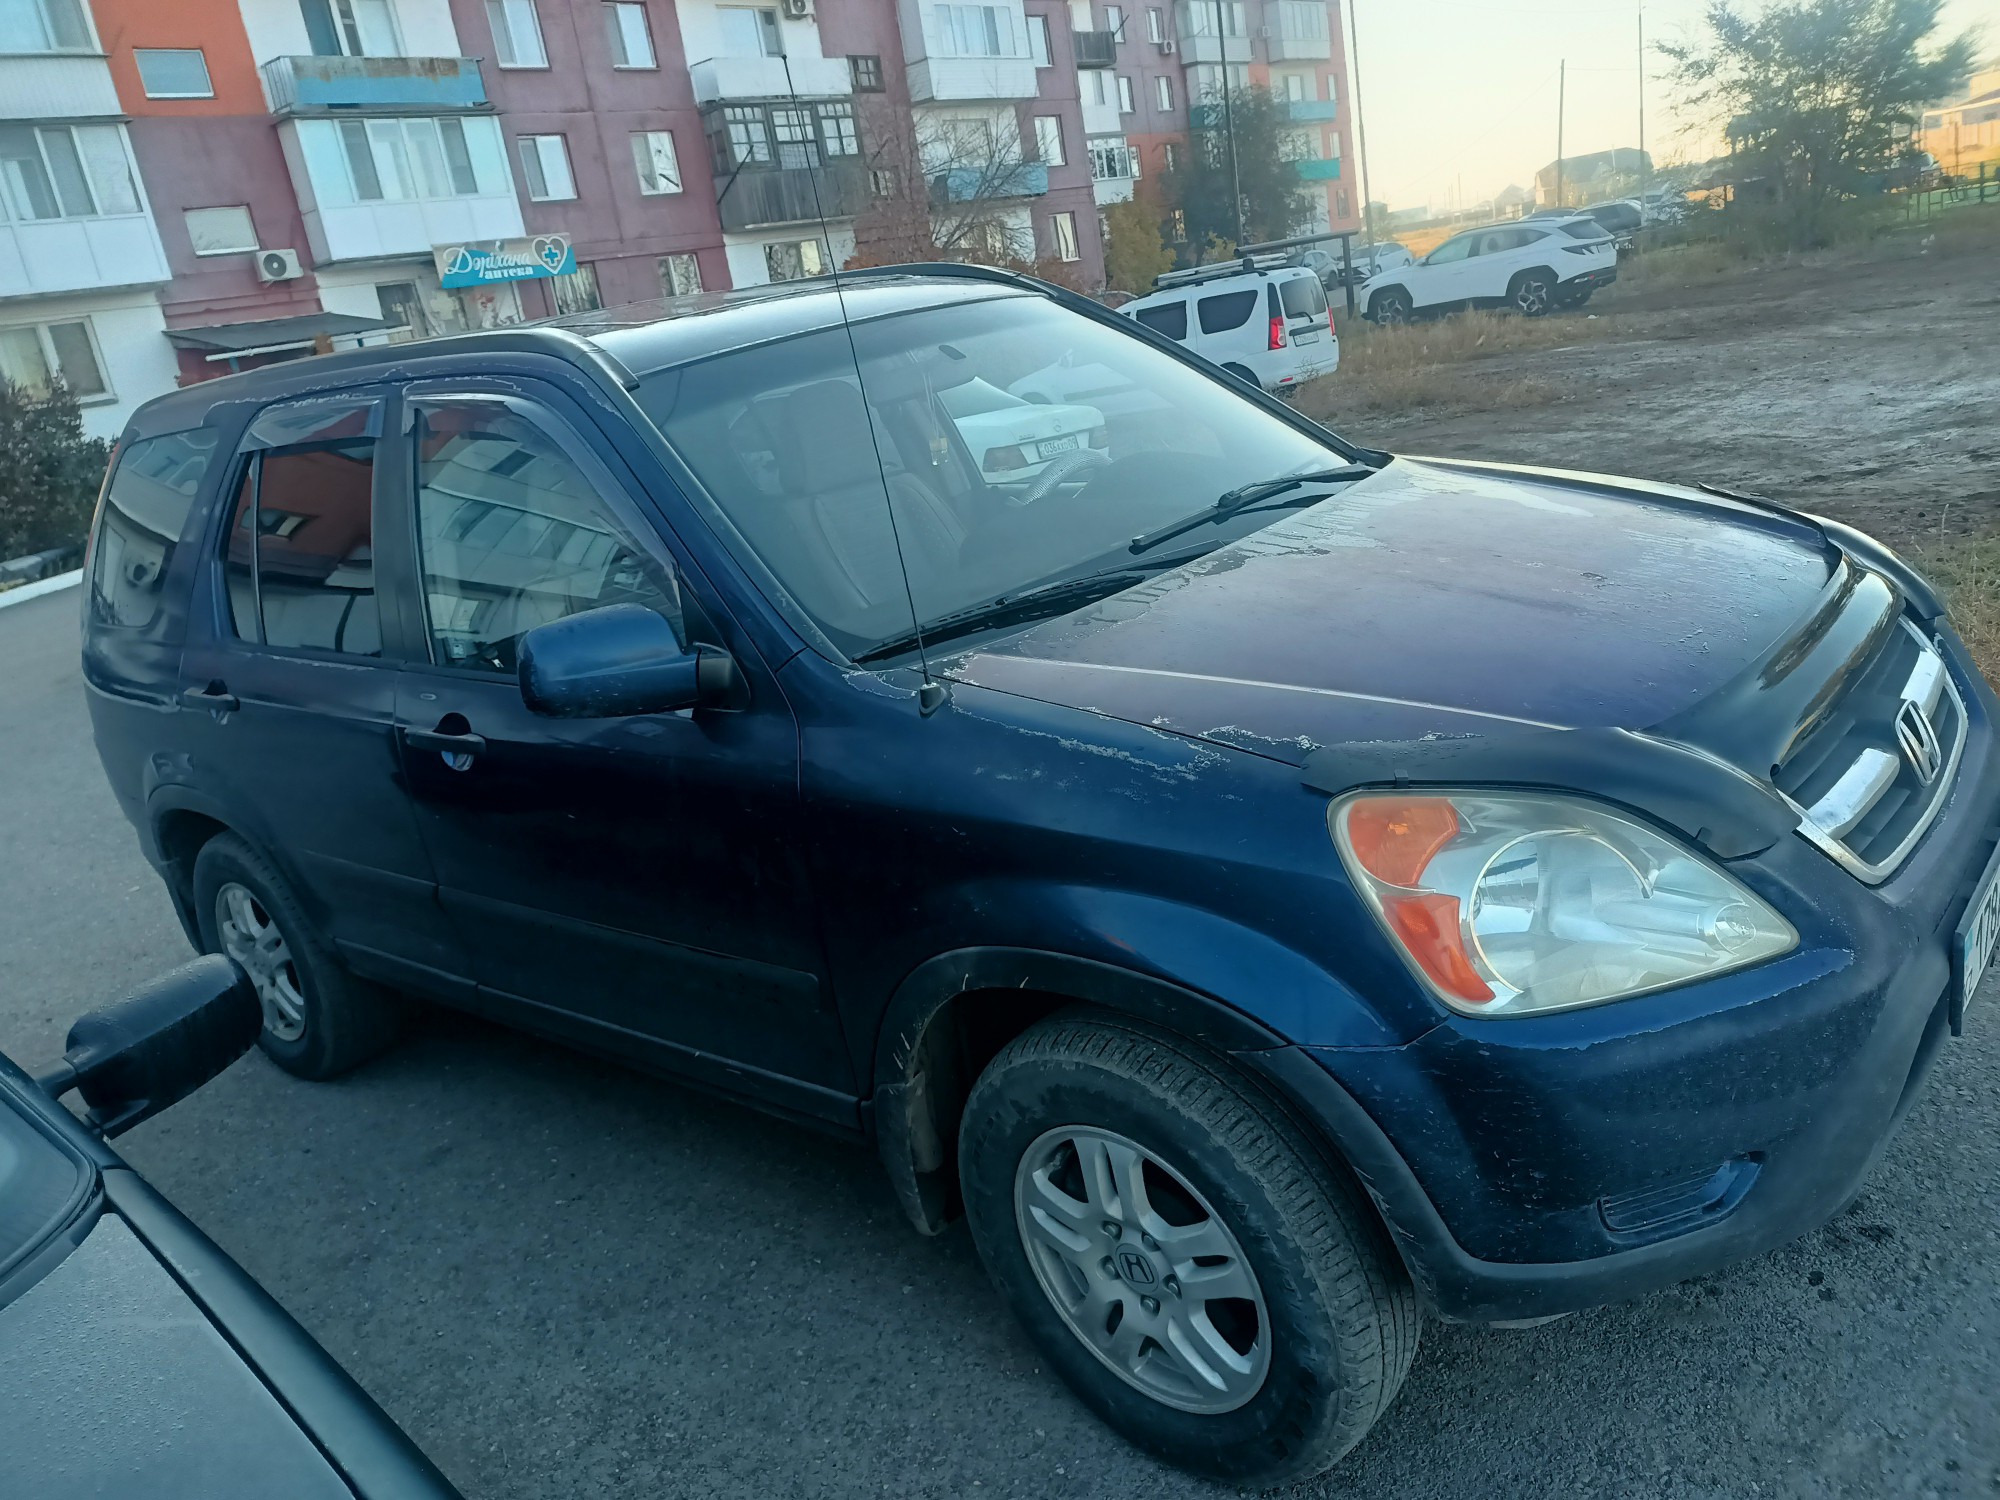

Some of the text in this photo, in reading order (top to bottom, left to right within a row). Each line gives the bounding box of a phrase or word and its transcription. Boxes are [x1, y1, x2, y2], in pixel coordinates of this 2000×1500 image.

[443, 246, 532, 278] Дәріхана
[484, 266, 534, 280] аптека
[1976, 881, 2000, 971] 178
